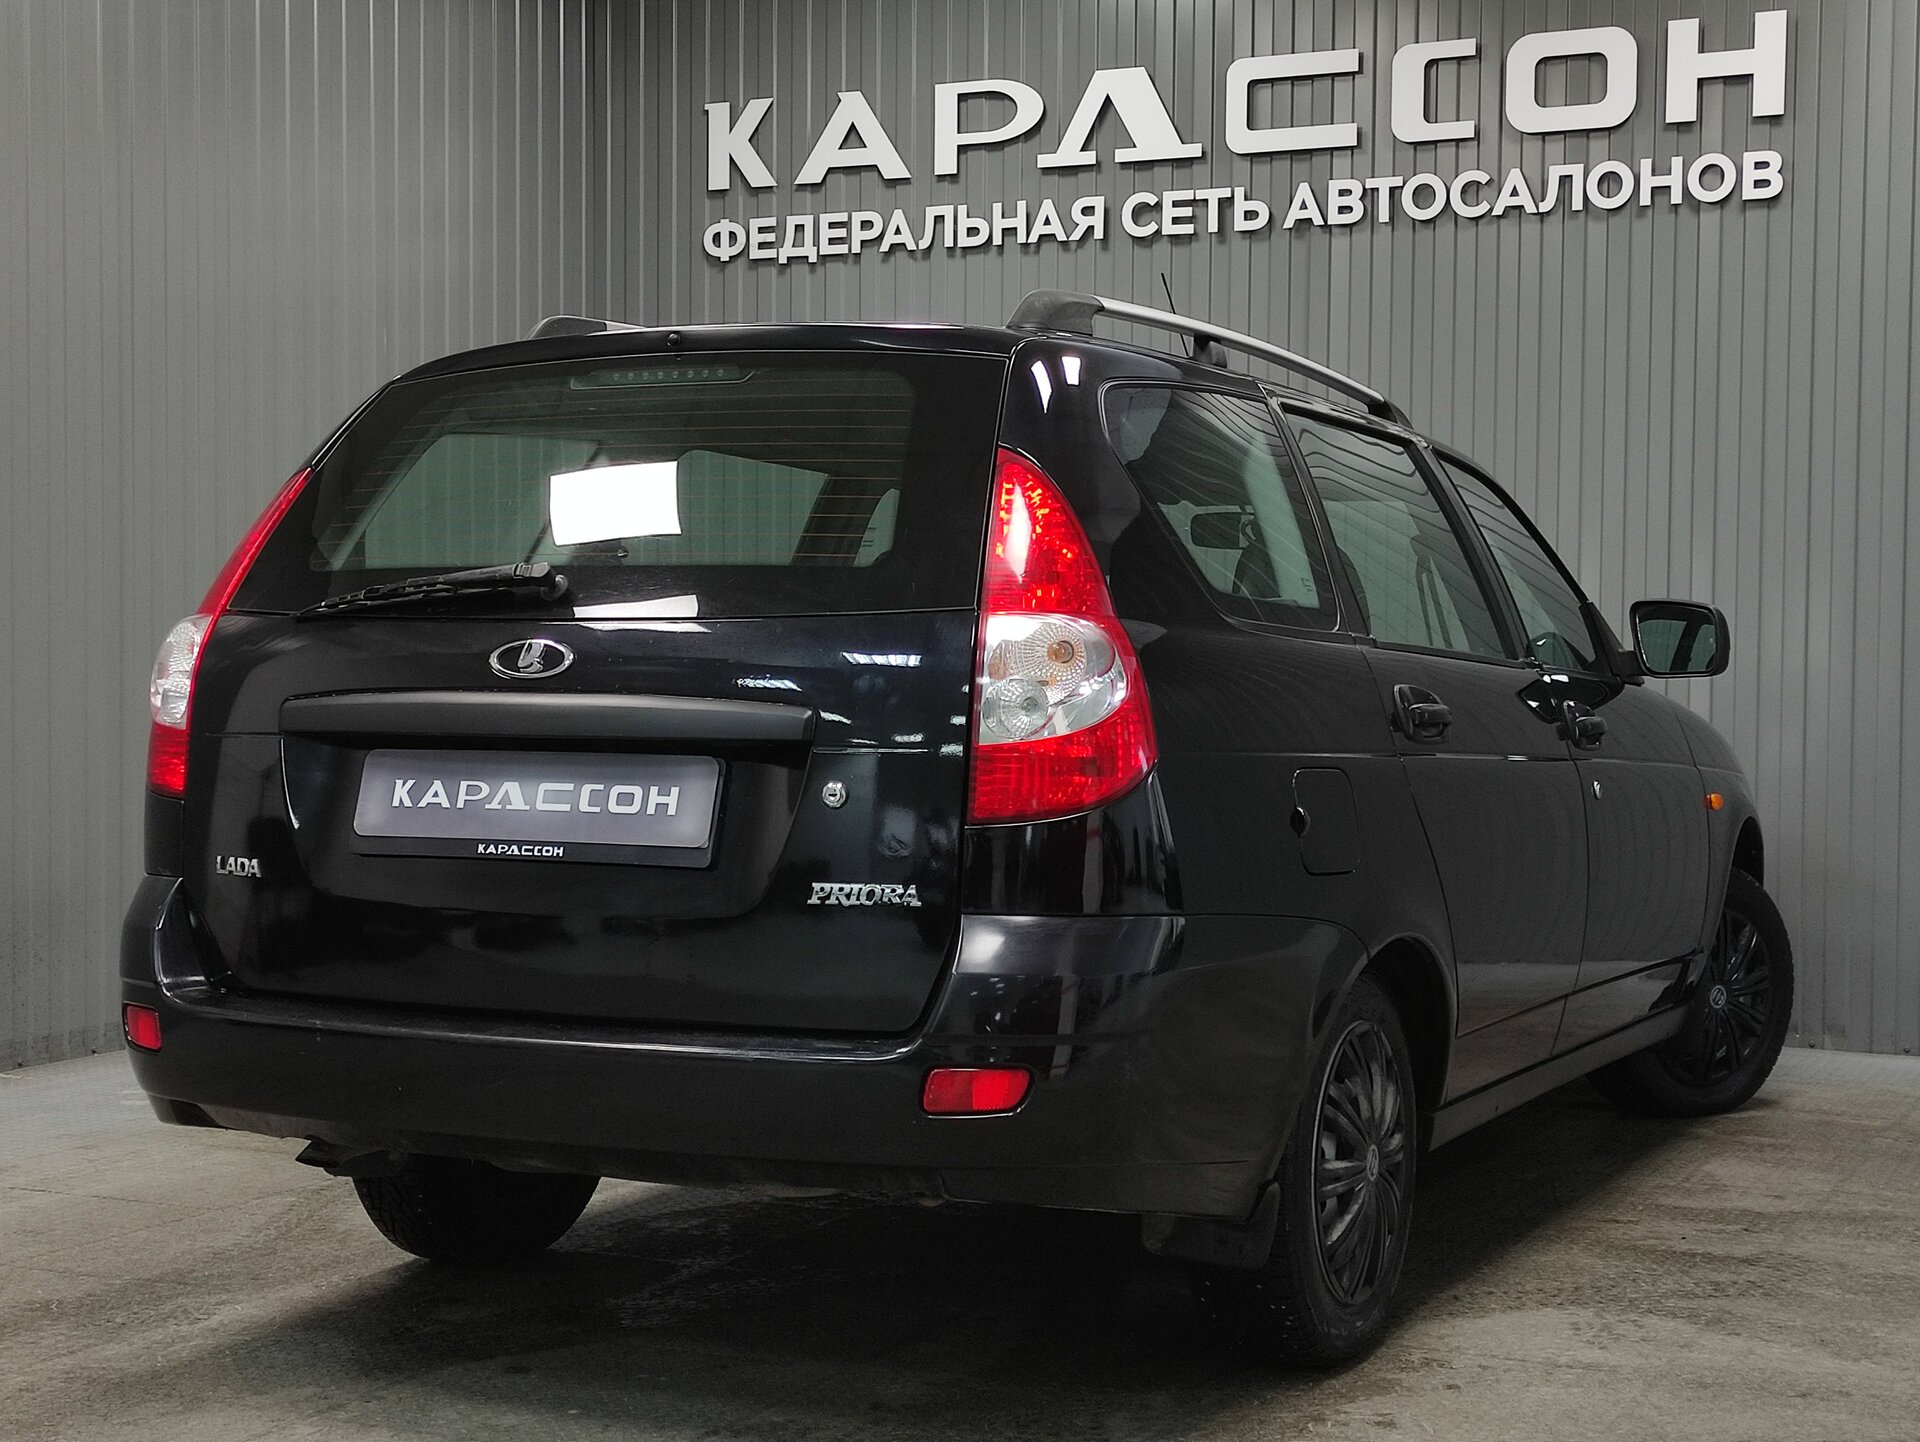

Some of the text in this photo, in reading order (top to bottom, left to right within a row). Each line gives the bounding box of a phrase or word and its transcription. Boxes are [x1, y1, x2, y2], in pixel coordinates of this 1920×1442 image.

[703, 150, 1785, 264] ФЕДЕРАЛЬНАЯ СЕТЬ АВТОСАЛОНОВ
[216, 855, 262, 878] LADA
[806, 882, 922, 907] PRIORA
